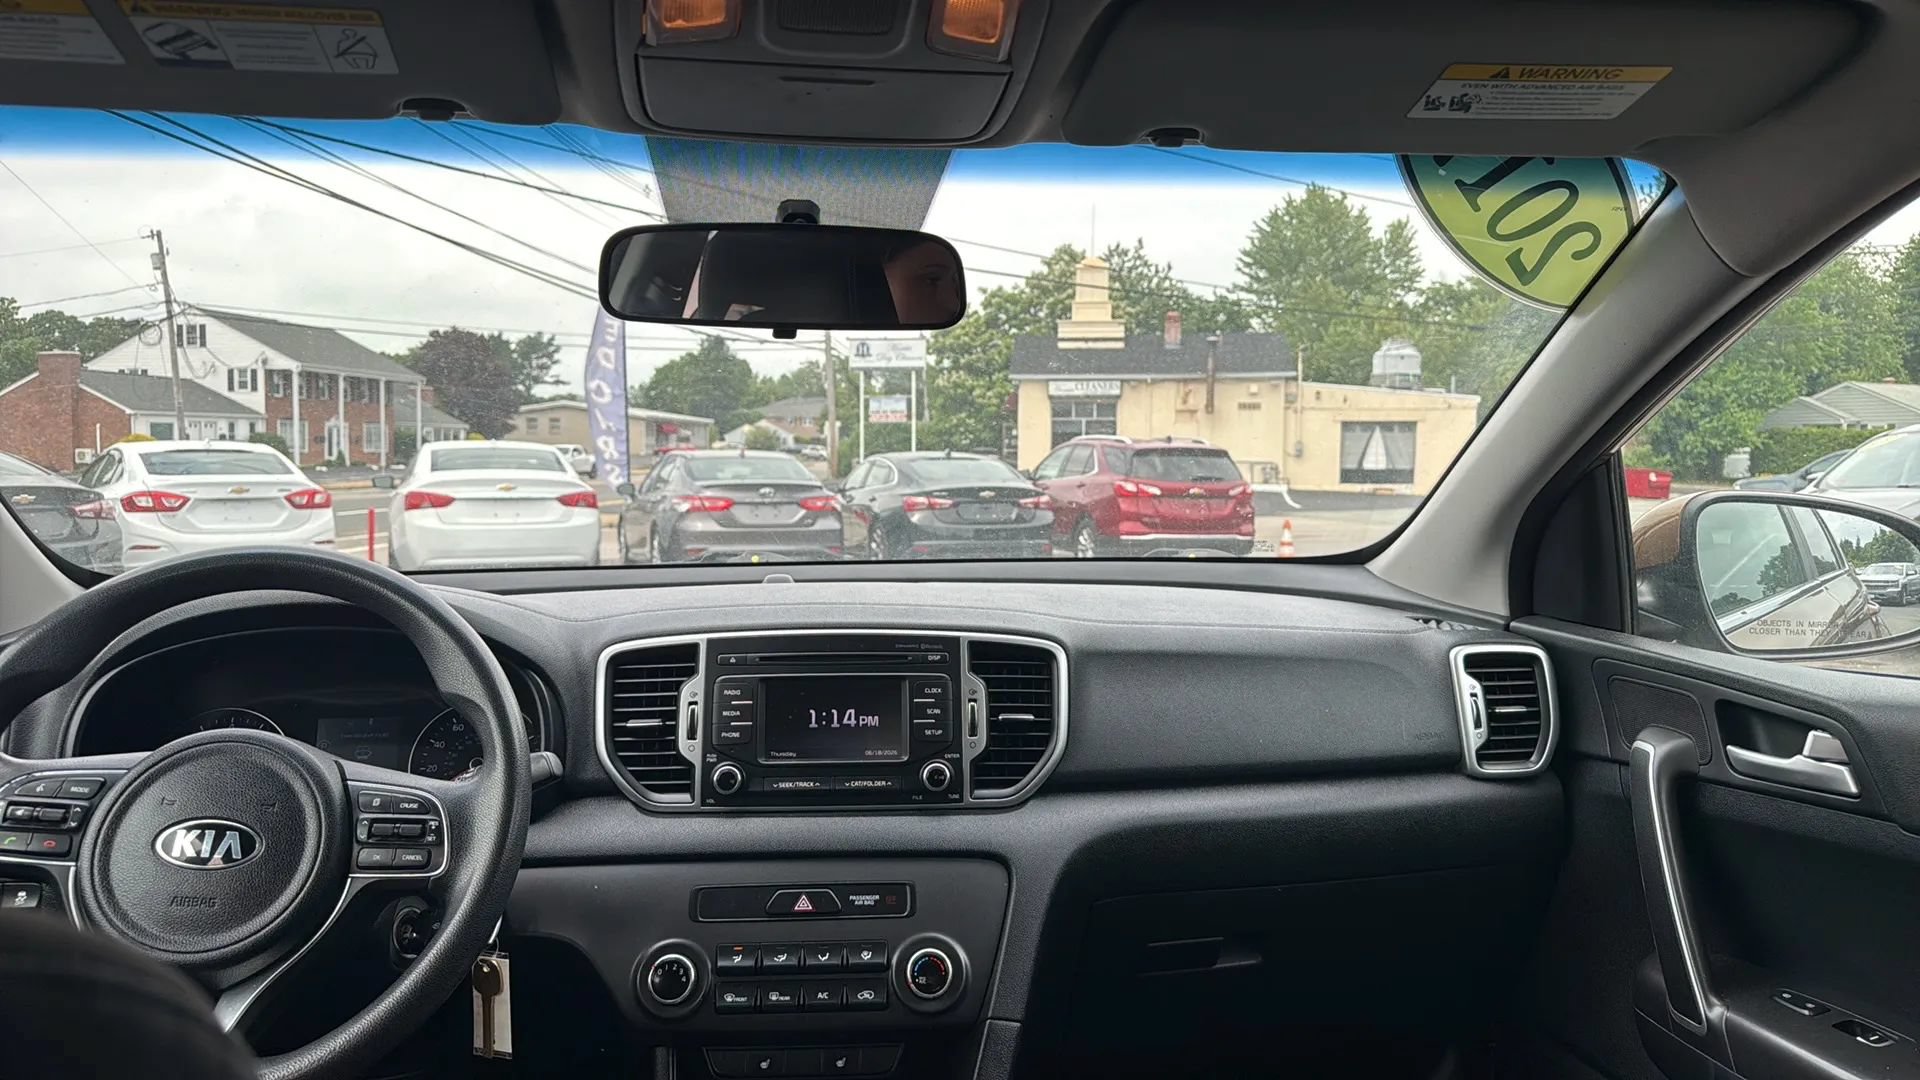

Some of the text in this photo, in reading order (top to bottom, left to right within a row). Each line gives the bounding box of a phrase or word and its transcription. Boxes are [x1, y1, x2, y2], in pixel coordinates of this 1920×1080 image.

[1518, 67, 1624, 81] WARNING
[1757, 619, 1792, 627] OBJECTS
[1795, 620, 1804, 628] IN
[1748, 627, 1781, 635] CLOSER
[1785, 628, 1807, 636] THAN
[453, 724, 465, 732] 60
[435, 740, 446, 749] 40
[427, 764, 439, 773] 20
[778, 780, 814, 789] SEEK/TRACK
[850, 780, 887, 788] CAT/FOLDER
[170, 828, 242, 860] KIA
[170, 896, 217, 909] AIRBAG
[817, 991, 830, 999] A/C
